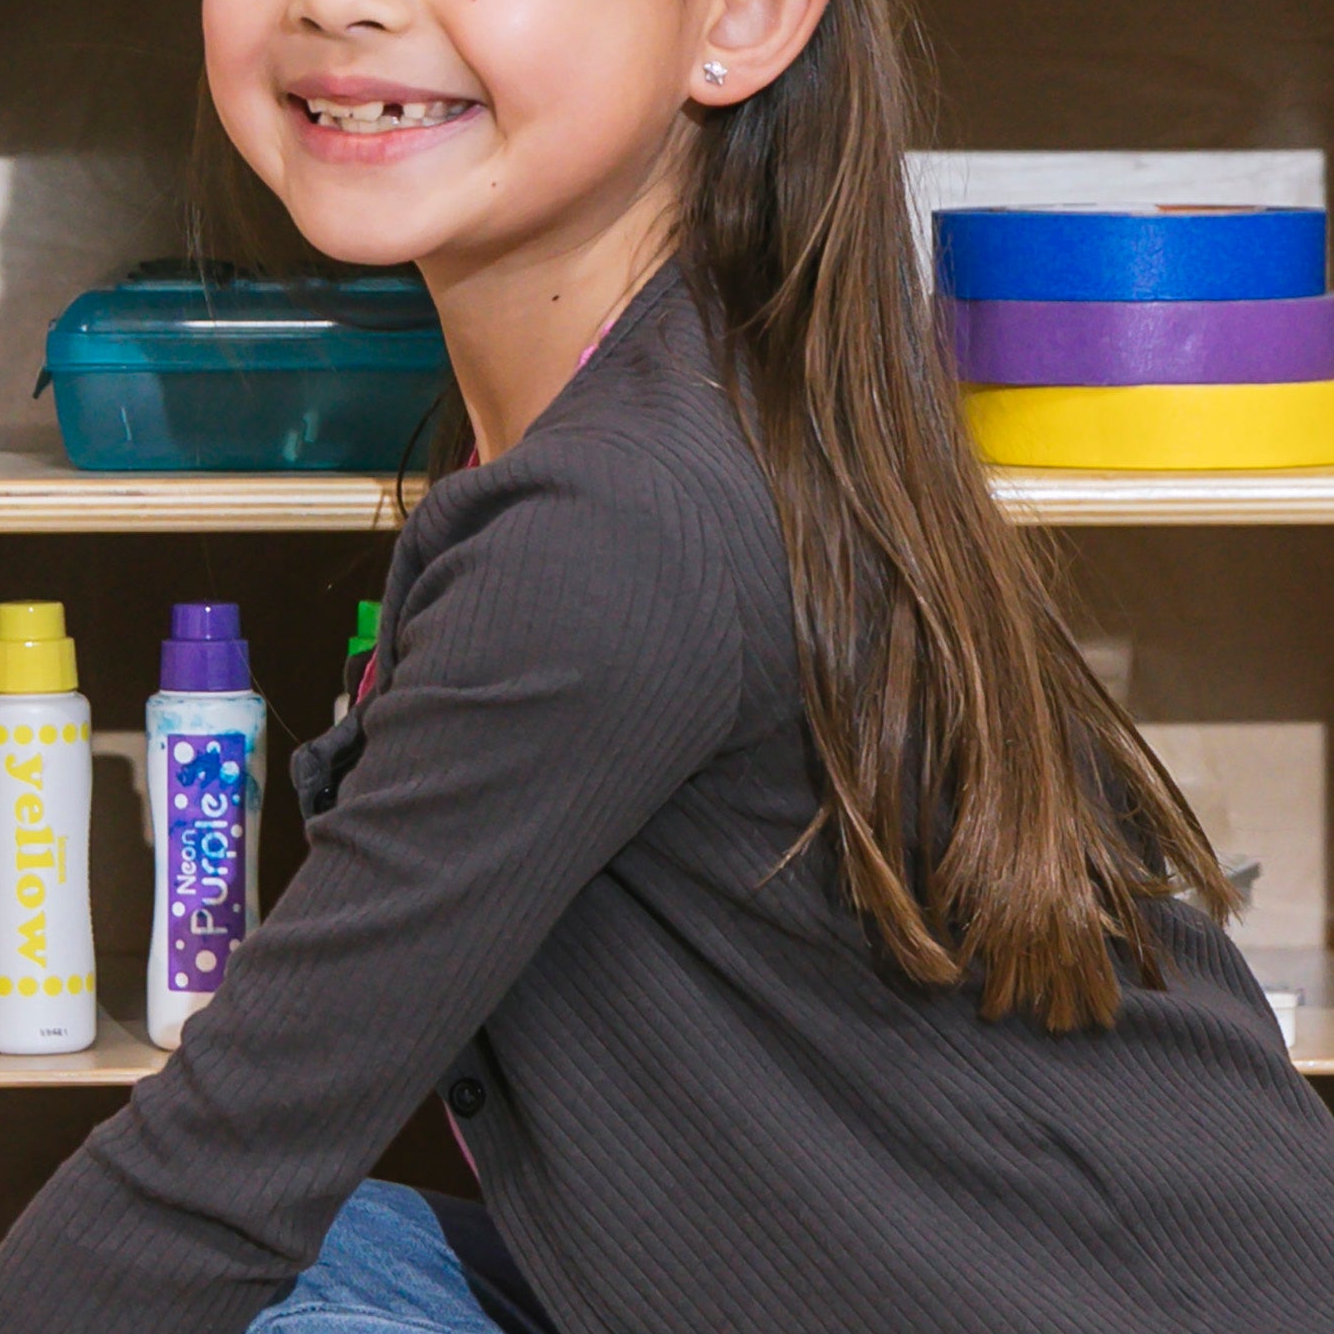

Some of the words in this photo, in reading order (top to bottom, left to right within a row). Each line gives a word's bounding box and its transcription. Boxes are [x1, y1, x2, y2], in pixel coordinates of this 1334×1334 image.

[4, 753, 56, 968] yellow
[177, 829, 196, 895] Neon
[189, 793, 237, 935] Purple
